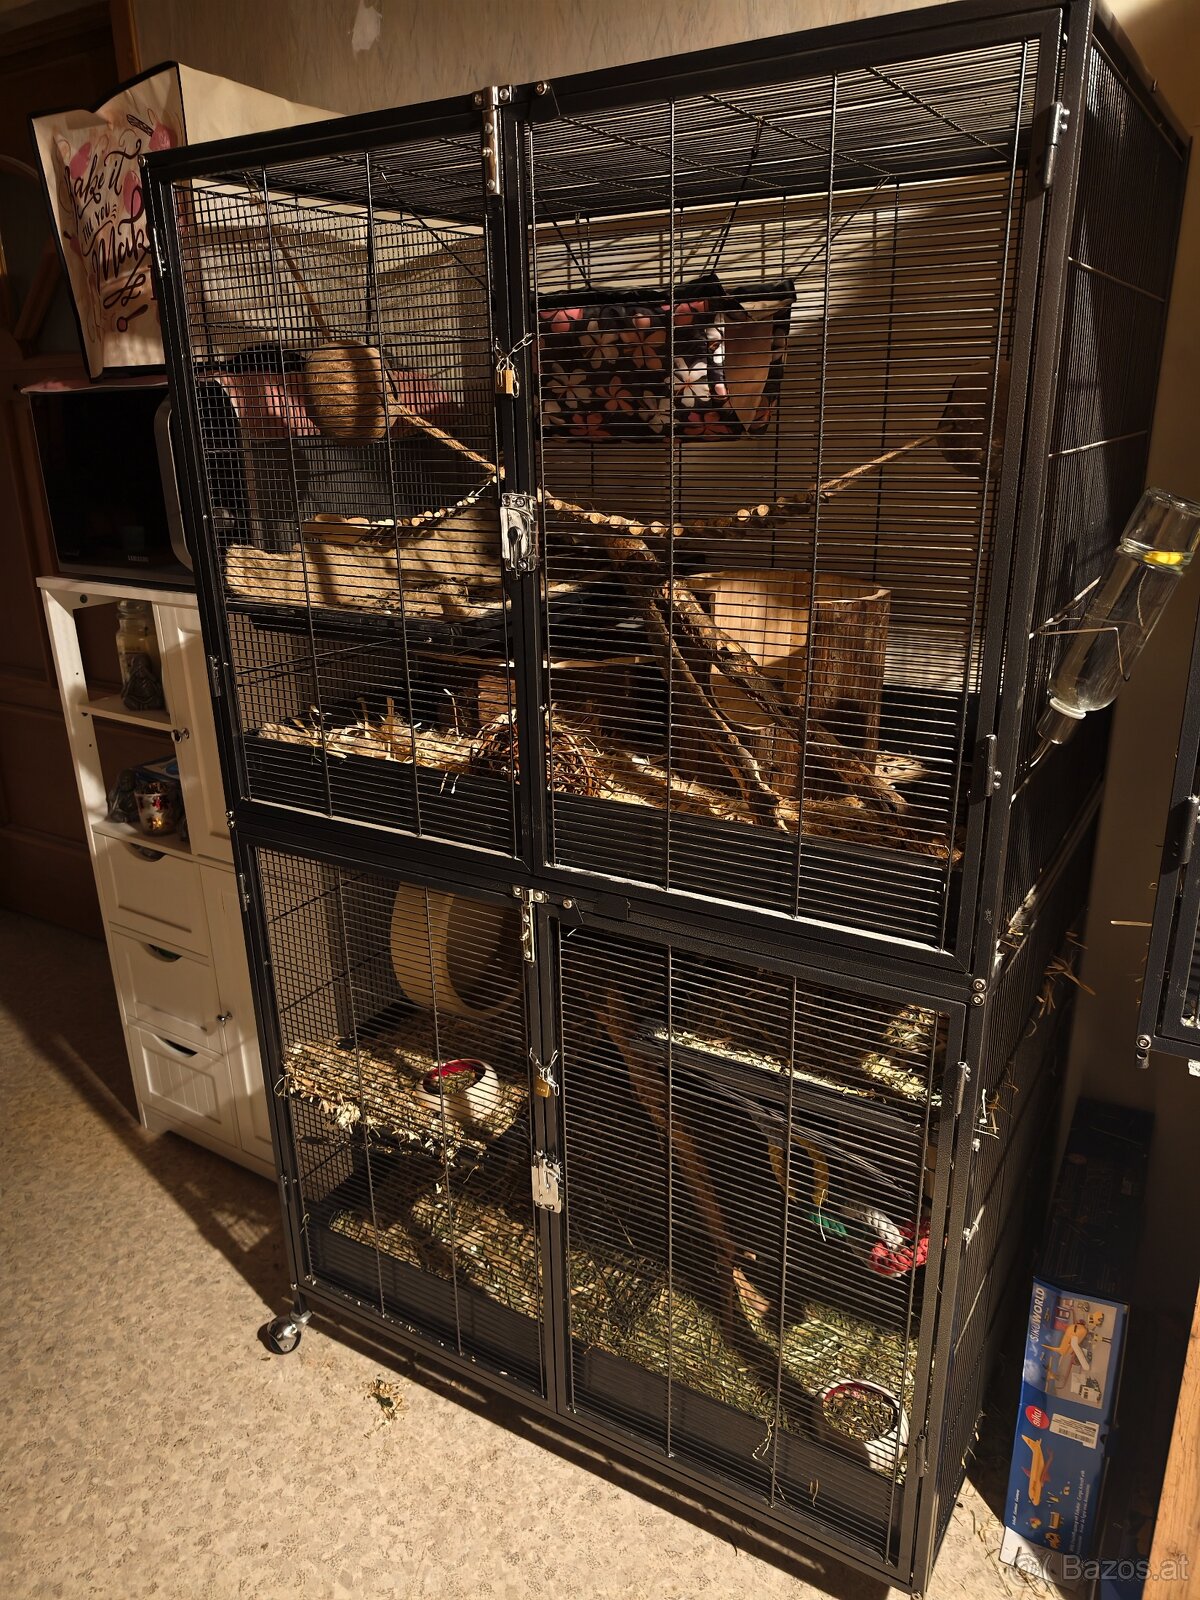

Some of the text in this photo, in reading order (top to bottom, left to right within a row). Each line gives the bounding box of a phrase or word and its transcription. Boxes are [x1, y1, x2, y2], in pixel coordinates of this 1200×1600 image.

[104, 138, 143, 197] it
[88, 186, 152, 300] Mak
[93, 201, 111, 227] YOU
